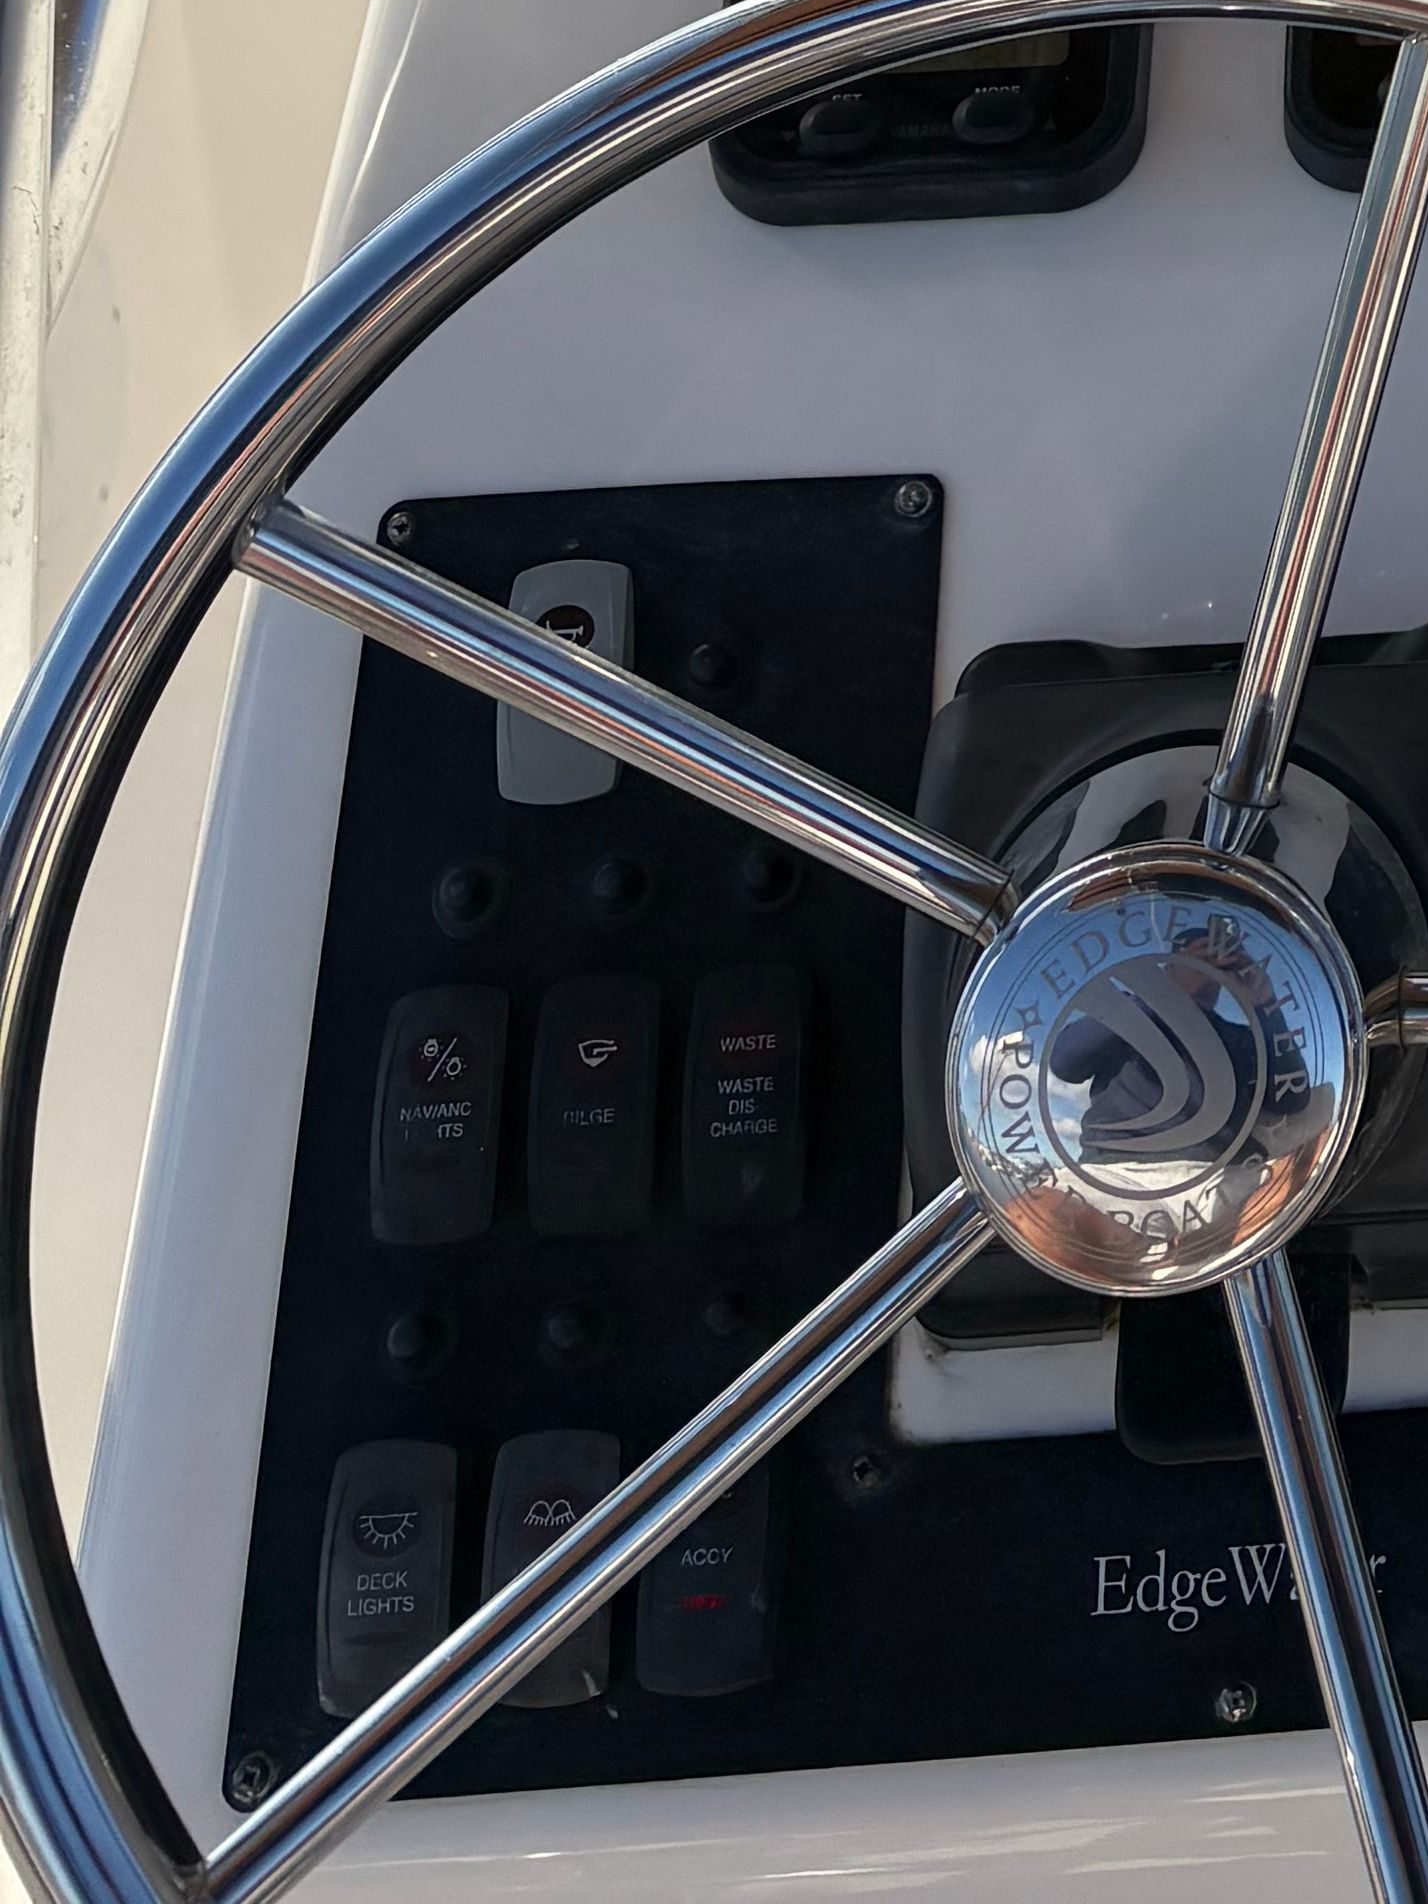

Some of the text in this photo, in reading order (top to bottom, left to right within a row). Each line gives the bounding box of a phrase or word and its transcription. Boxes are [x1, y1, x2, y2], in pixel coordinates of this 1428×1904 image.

[719, 1033, 777, 1053] WASTE
[717, 1075, 775, 1095] WASTE
[709, 1118, 779, 1138] CHARGE
[680, 1546, 734, 1567] ACCY
[356, 1570, 408, 1592] DECK
[1091, 1542, 1387, 1632] EdgeWr
[347, 1595, 415, 1618] LIGHTS
